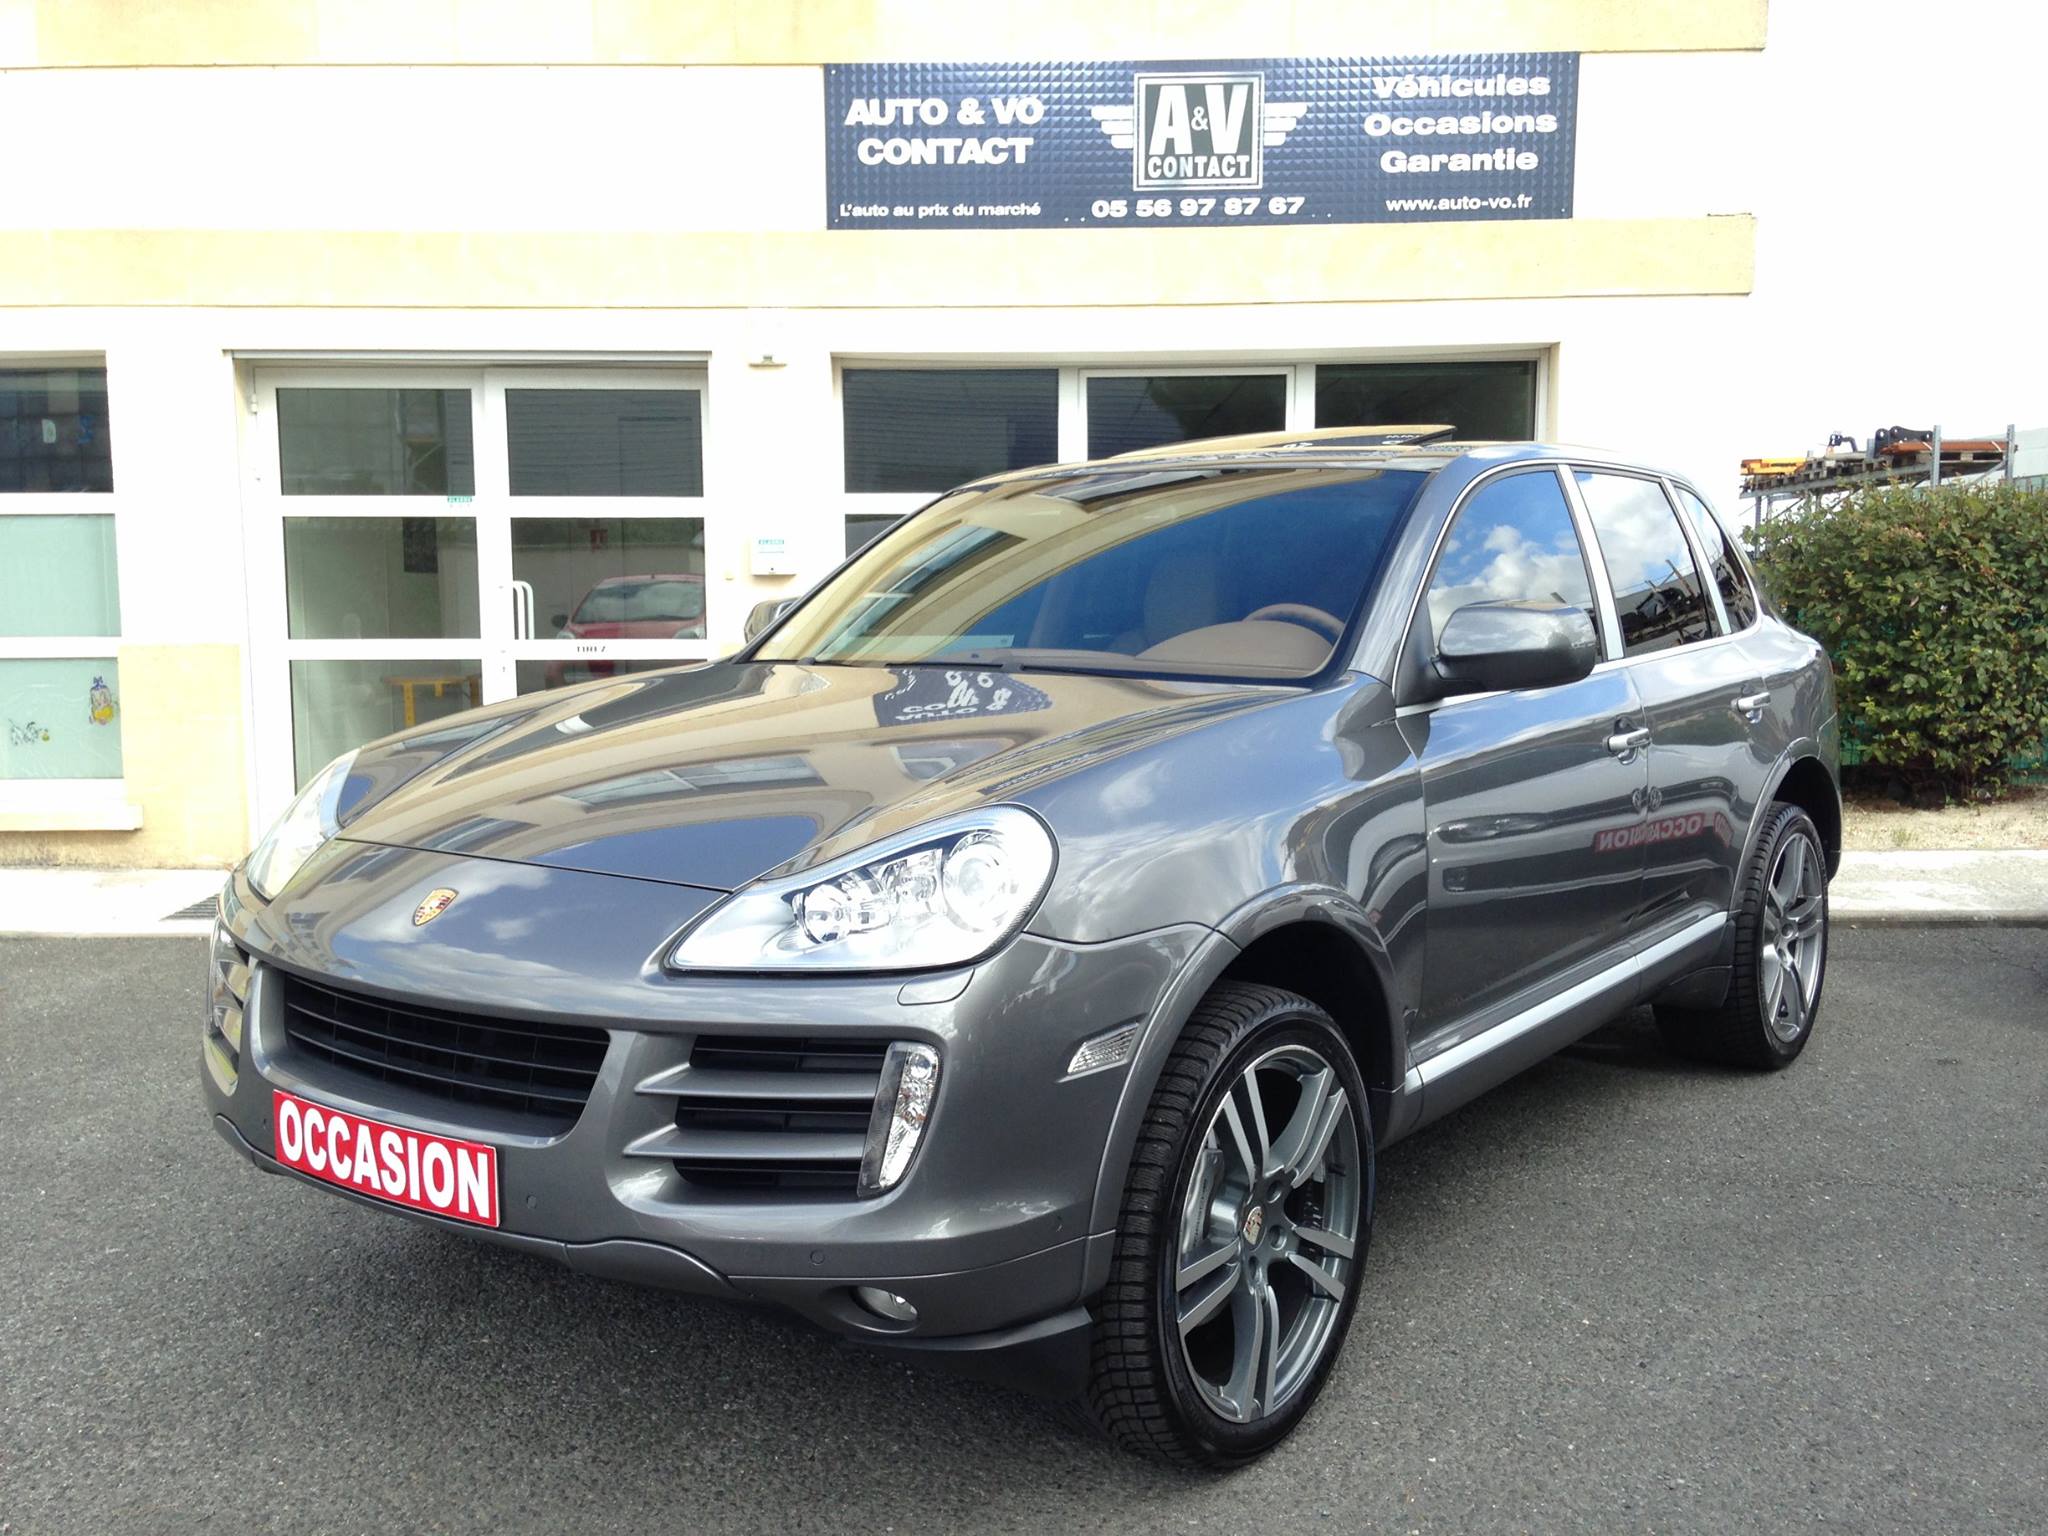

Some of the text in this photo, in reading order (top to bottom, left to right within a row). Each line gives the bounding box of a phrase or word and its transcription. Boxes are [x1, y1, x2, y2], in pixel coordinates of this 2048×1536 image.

[1372, 74, 1551, 98] Véhicules
[844, 97, 1045, 126] AUTO & VO
[1148, 84, 1249, 155] A&V
[1363, 111, 1558, 136] Occasions
[857, 137, 1034, 165] CONTACT
[1380, 147, 1539, 173] Garantie
[1147, 155, 1250, 179] CONTACT
[840, 202, 1041, 219] L'auto au prix du marché
[1091, 196, 1306, 218] 05 56 97 87 67
[1386, 194, 1533, 212] www.auto-vo.fr
[279, 1099, 490, 1219] OCCASION
